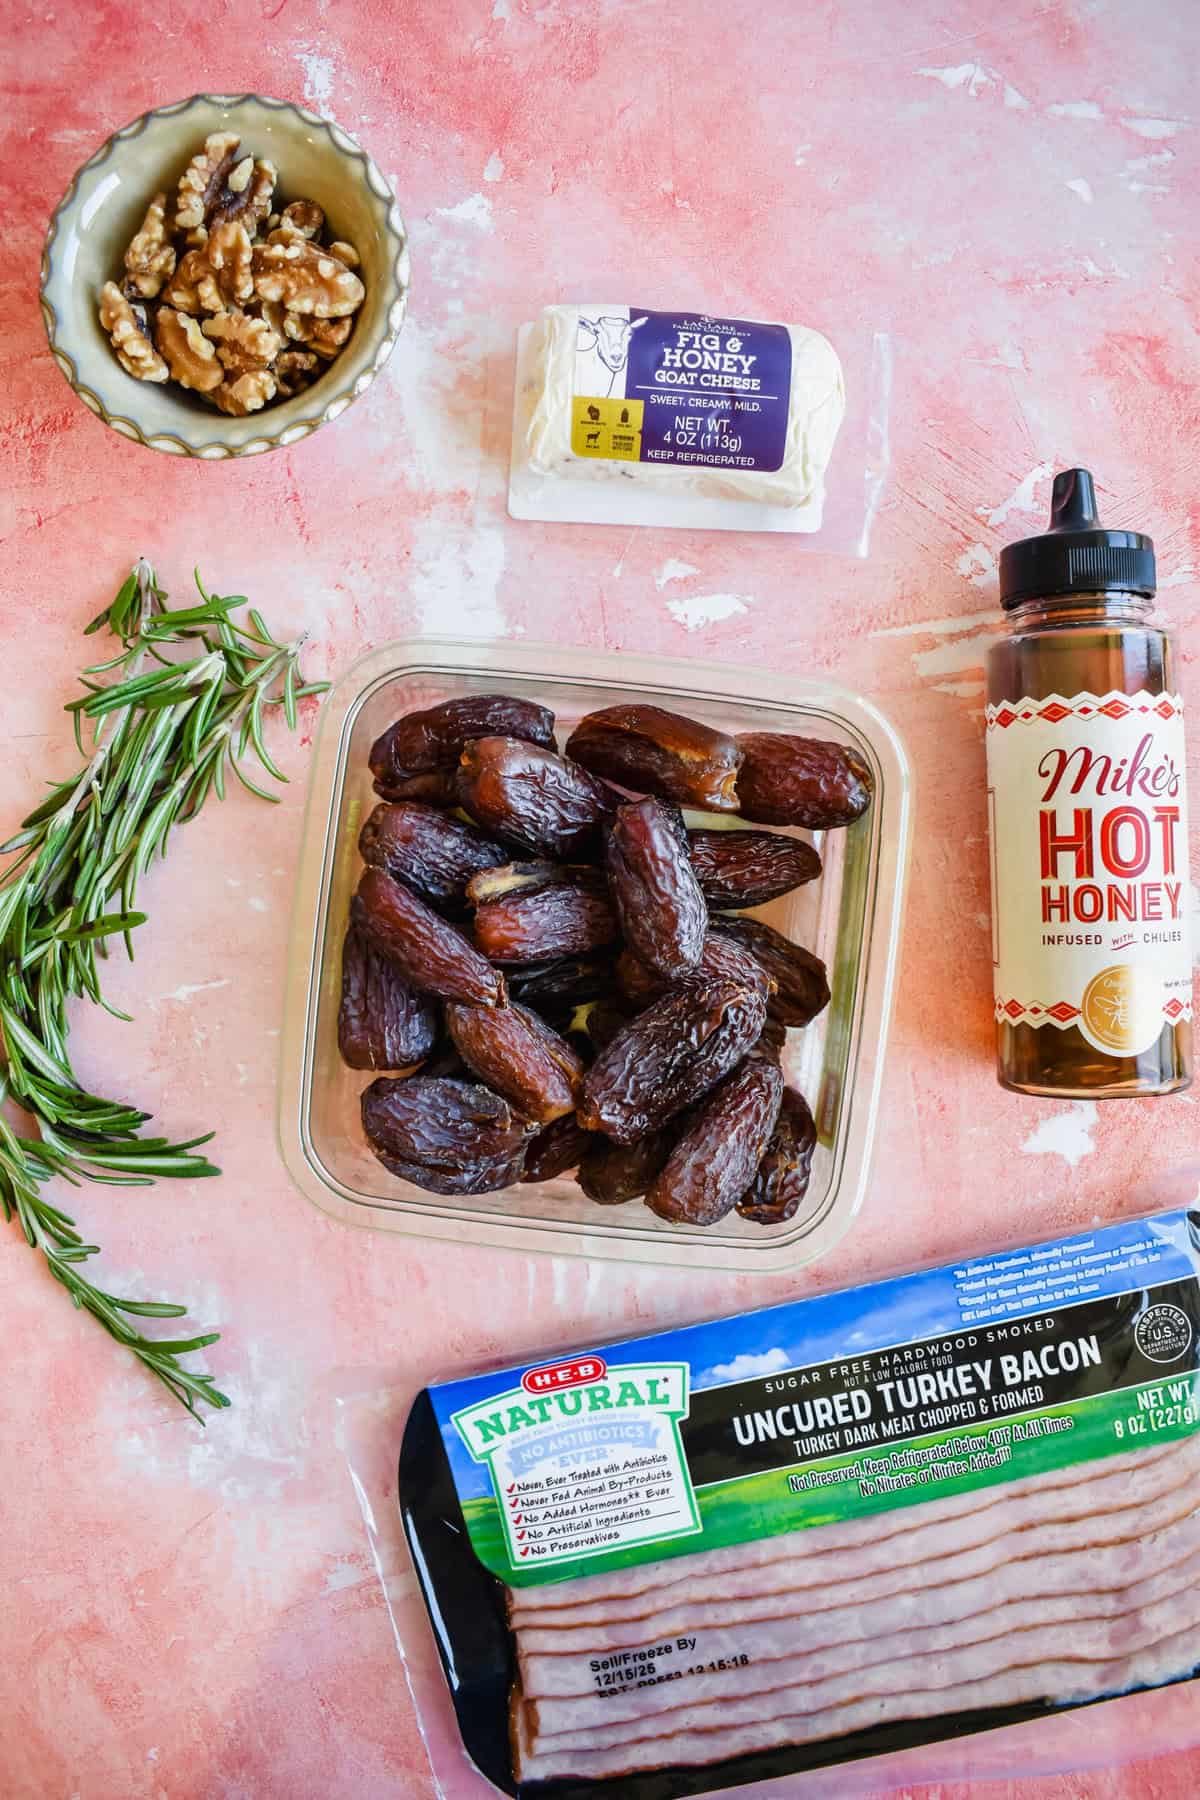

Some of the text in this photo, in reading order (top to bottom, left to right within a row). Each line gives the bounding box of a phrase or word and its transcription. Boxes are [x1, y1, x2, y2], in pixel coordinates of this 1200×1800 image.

[677, 331, 744, 353] FIG &
[662, 348, 757, 375] HONEY
[655, 369, 761, 391] GOAT CHEESE
[650, 394, 762, 412] SWEET. CREAMY. MILD.
[675, 416, 733, 433] NET WT.
[647, 449, 755, 466] KEEP REFRIGERATED
[663, 431, 742, 452] 4 OZ (113g)
[1038, 733, 1181, 802] Mike's
[1039, 805, 1180, 880] HOT
[1041, 882, 1181, 924] HONEY
[1042, 931, 1181, 946] INFUSED WITH CHILIES
[1139, 1307, 1185, 1336] INSPECTED
[1152, 1326, 1175, 1340] U.S.
[765, 1317, 1055, 1393] SUGAR FREE HARDWOOD SMOKED
[843, 1354, 953, 1388] NOT A LOW CALORIE FOOD
[733, 1335, 1102, 1446] UNCURED TURKEY BACON
[1136, 1387, 1165, 1411] NET
[793, 1385, 1044, 1457] TURKEY DARK MEAT CHOPPED & FORMED
[1114, 1396, 1198, 1438] 8 OZ (227g)
[520, 1444, 545, 1463] NO
[550, 1424, 645, 1452] ANTIBIOTICS
[558, 1448, 608, 1467] EVER
[790, 1475, 810, 1492] Not
[811, 1463, 864, 1488] Preserved,
[864, 1457, 890, 1475] Keep
[892, 1442, 953, 1469] Refrigerated
[955, 1435, 986, 1452] Below
[1013, 1425, 1024, 1441] At
[1026, 1420, 1041, 1438] All
[1042, 1416, 1073, 1434] Times
[517, 1454, 668, 1492] Never, Ever Treated with Antibiotics
[521, 1470, 672, 1507] Never Fed Animal By-Products
[860, 1479, 874, 1498] No
[876, 1475, 916, 1493] Nitrates
[919, 1470, 929, 1484] or
[931, 1462, 968, 1481] Nitrites
[524, 1513, 539, 1523] No
[543, 1505, 577, 1520] Added
[645, 1487, 670, 1499] Ever
[528, 1508, 651, 1540] No Artificial Ingredients
[531, 1531, 620, 1555] No Preservatives
[590, 1638, 697, 1672] Sell/Freeze By
[594, 1662, 656, 1687] 12/15/25
